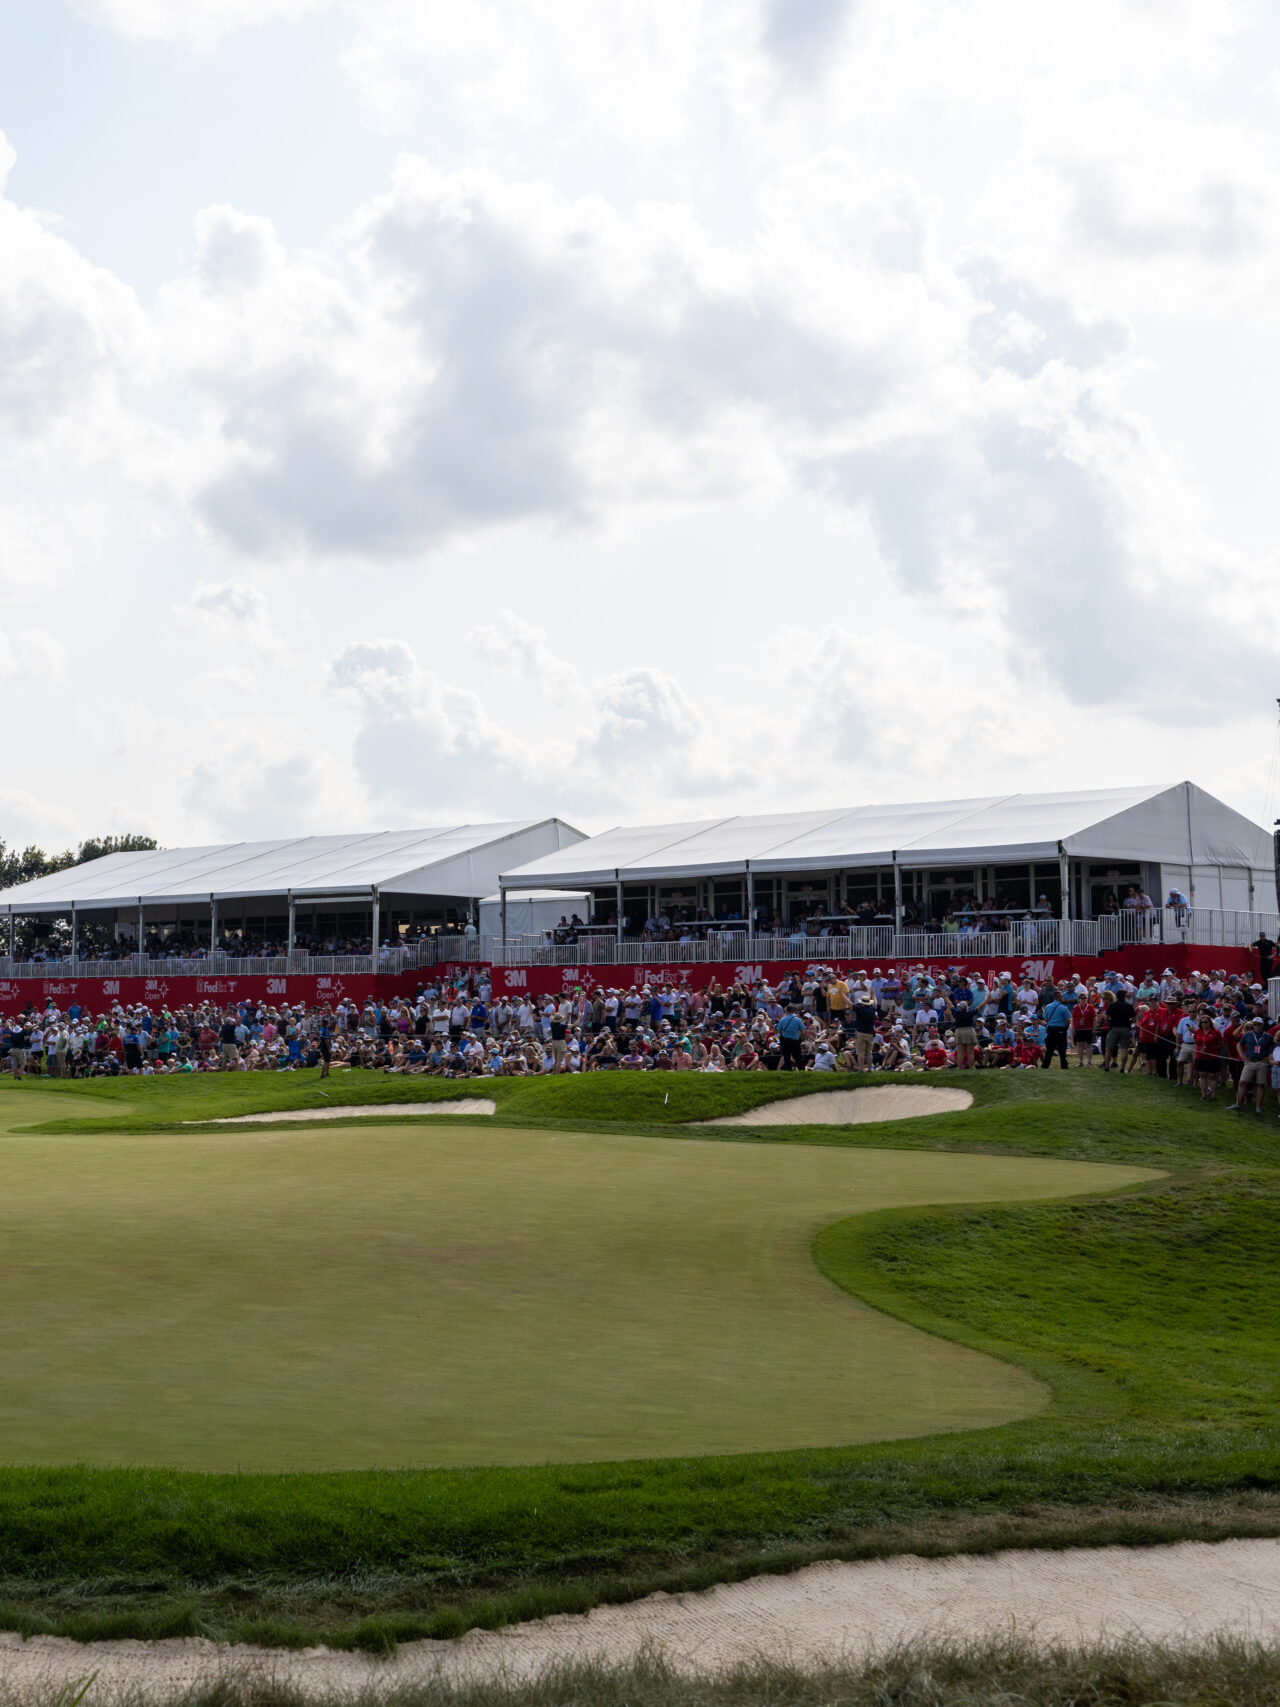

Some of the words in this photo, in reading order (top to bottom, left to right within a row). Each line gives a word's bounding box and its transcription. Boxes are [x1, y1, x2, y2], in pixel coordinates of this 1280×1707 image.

[562, 968, 579, 981] 3M
[644, 969, 678, 984] FedEx
[734, 965, 763, 985] 3M
[1019, 960, 1055, 981] 3M
[145, 979, 158, 991] 3M
[316, 977, 332, 989] 3M
[504, 969, 527, 988] 3M
[0, 981, 11, 992] 3M
[102, 980, 120, 995] 3M
[266, 978, 286, 994] 3M
[0, 992, 13, 1002] Open
[144, 991, 161, 1001] Open
[316, 990, 335, 1000] Open
